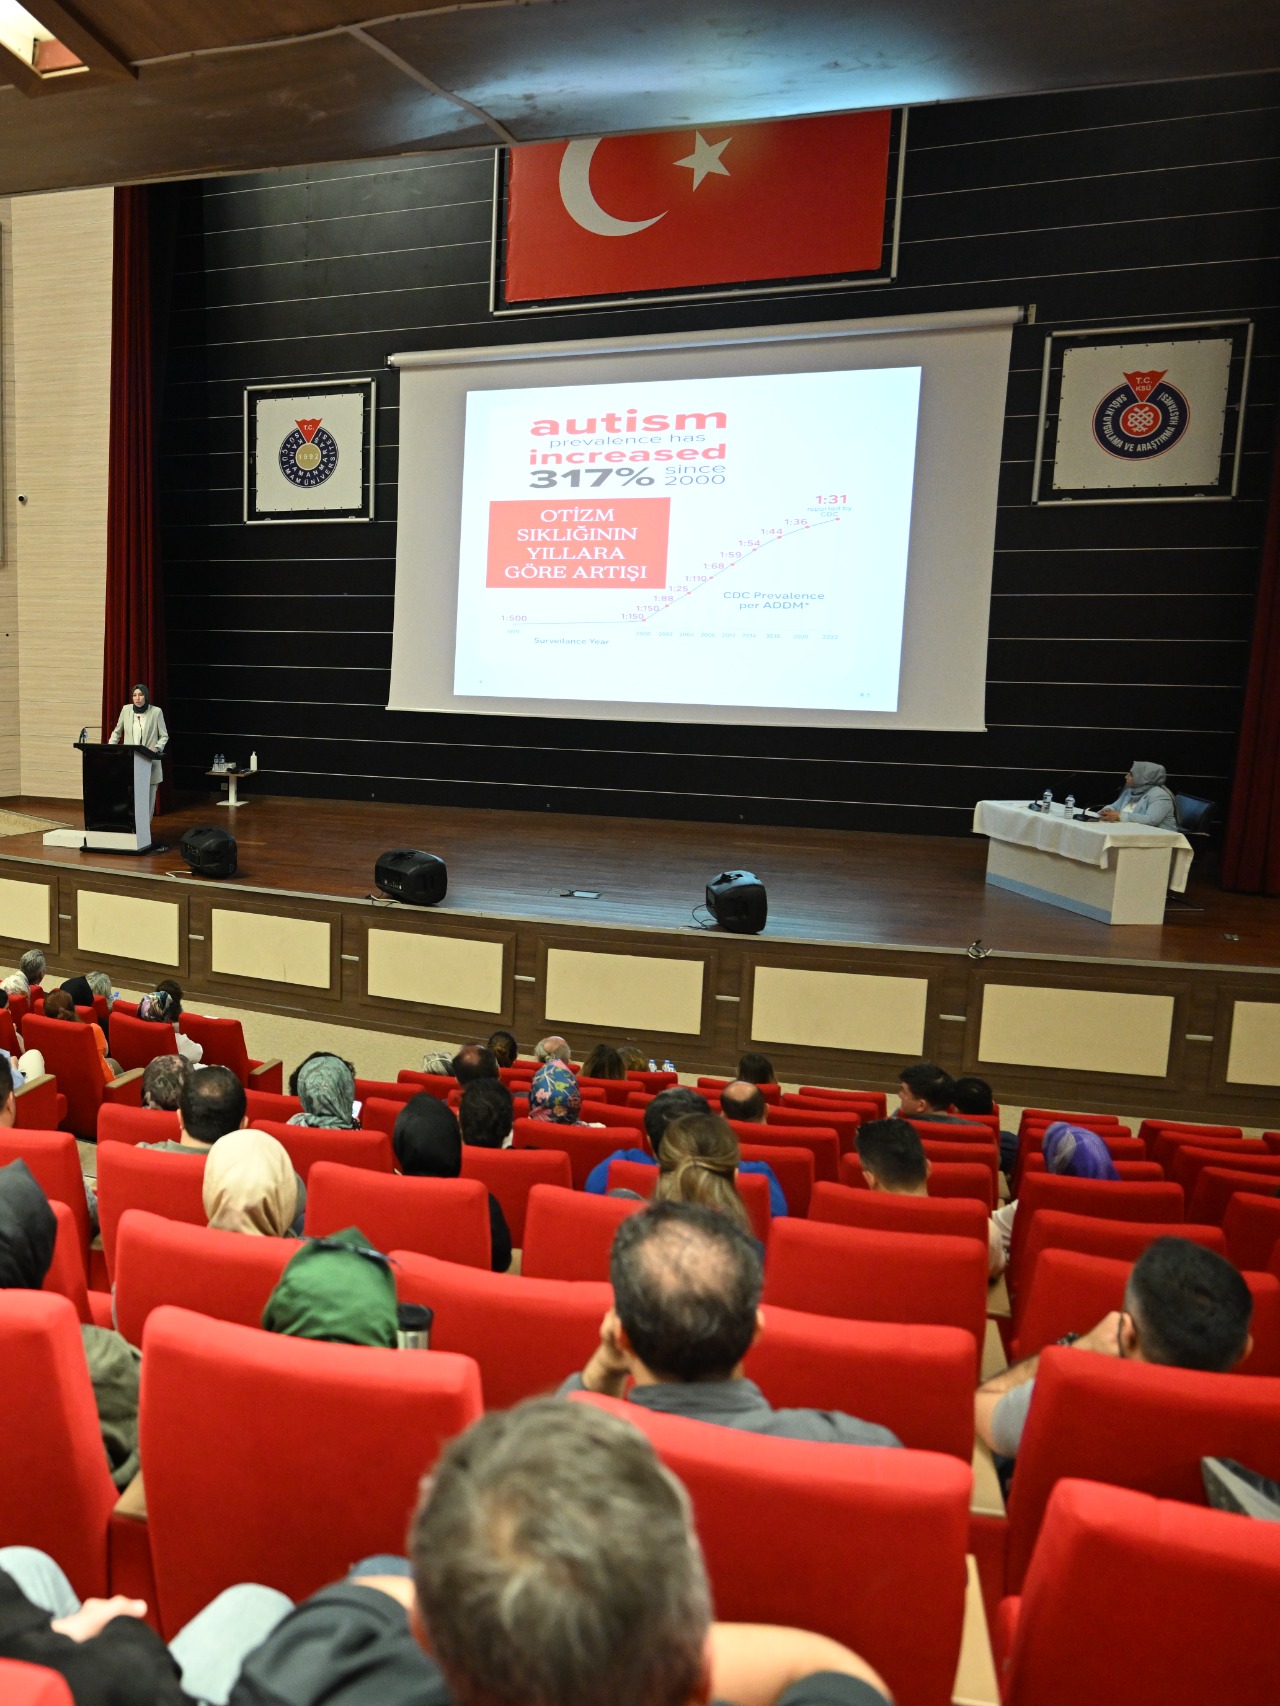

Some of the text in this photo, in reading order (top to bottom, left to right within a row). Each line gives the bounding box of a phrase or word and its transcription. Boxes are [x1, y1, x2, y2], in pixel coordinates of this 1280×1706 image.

[530, 408, 728, 436] autism
[1103, 416, 1124, 448] UYGULAMA
[1124, 442, 1134, 452] VE
[1136, 426, 1175, 452] ARAŞTIRMA
[1157, 392, 1179, 425] HASTANESİ
[549, 433, 706, 449] prevalence has
[529, 443, 727, 465] increased
[529, 466, 655, 489] 317%
[665, 464, 726, 475] since
[664, 474, 726, 486] 2000
[815, 494, 847, 504] 1:31
[540, 506, 615, 522] OTİZM
[517, 525, 638, 541] SIKLIĞININ
[527, 547, 625, 560] YILLARA
[504, 563, 647, 582] GÖRE ARTIŞI
[754, 591, 825, 600] Prevalence
